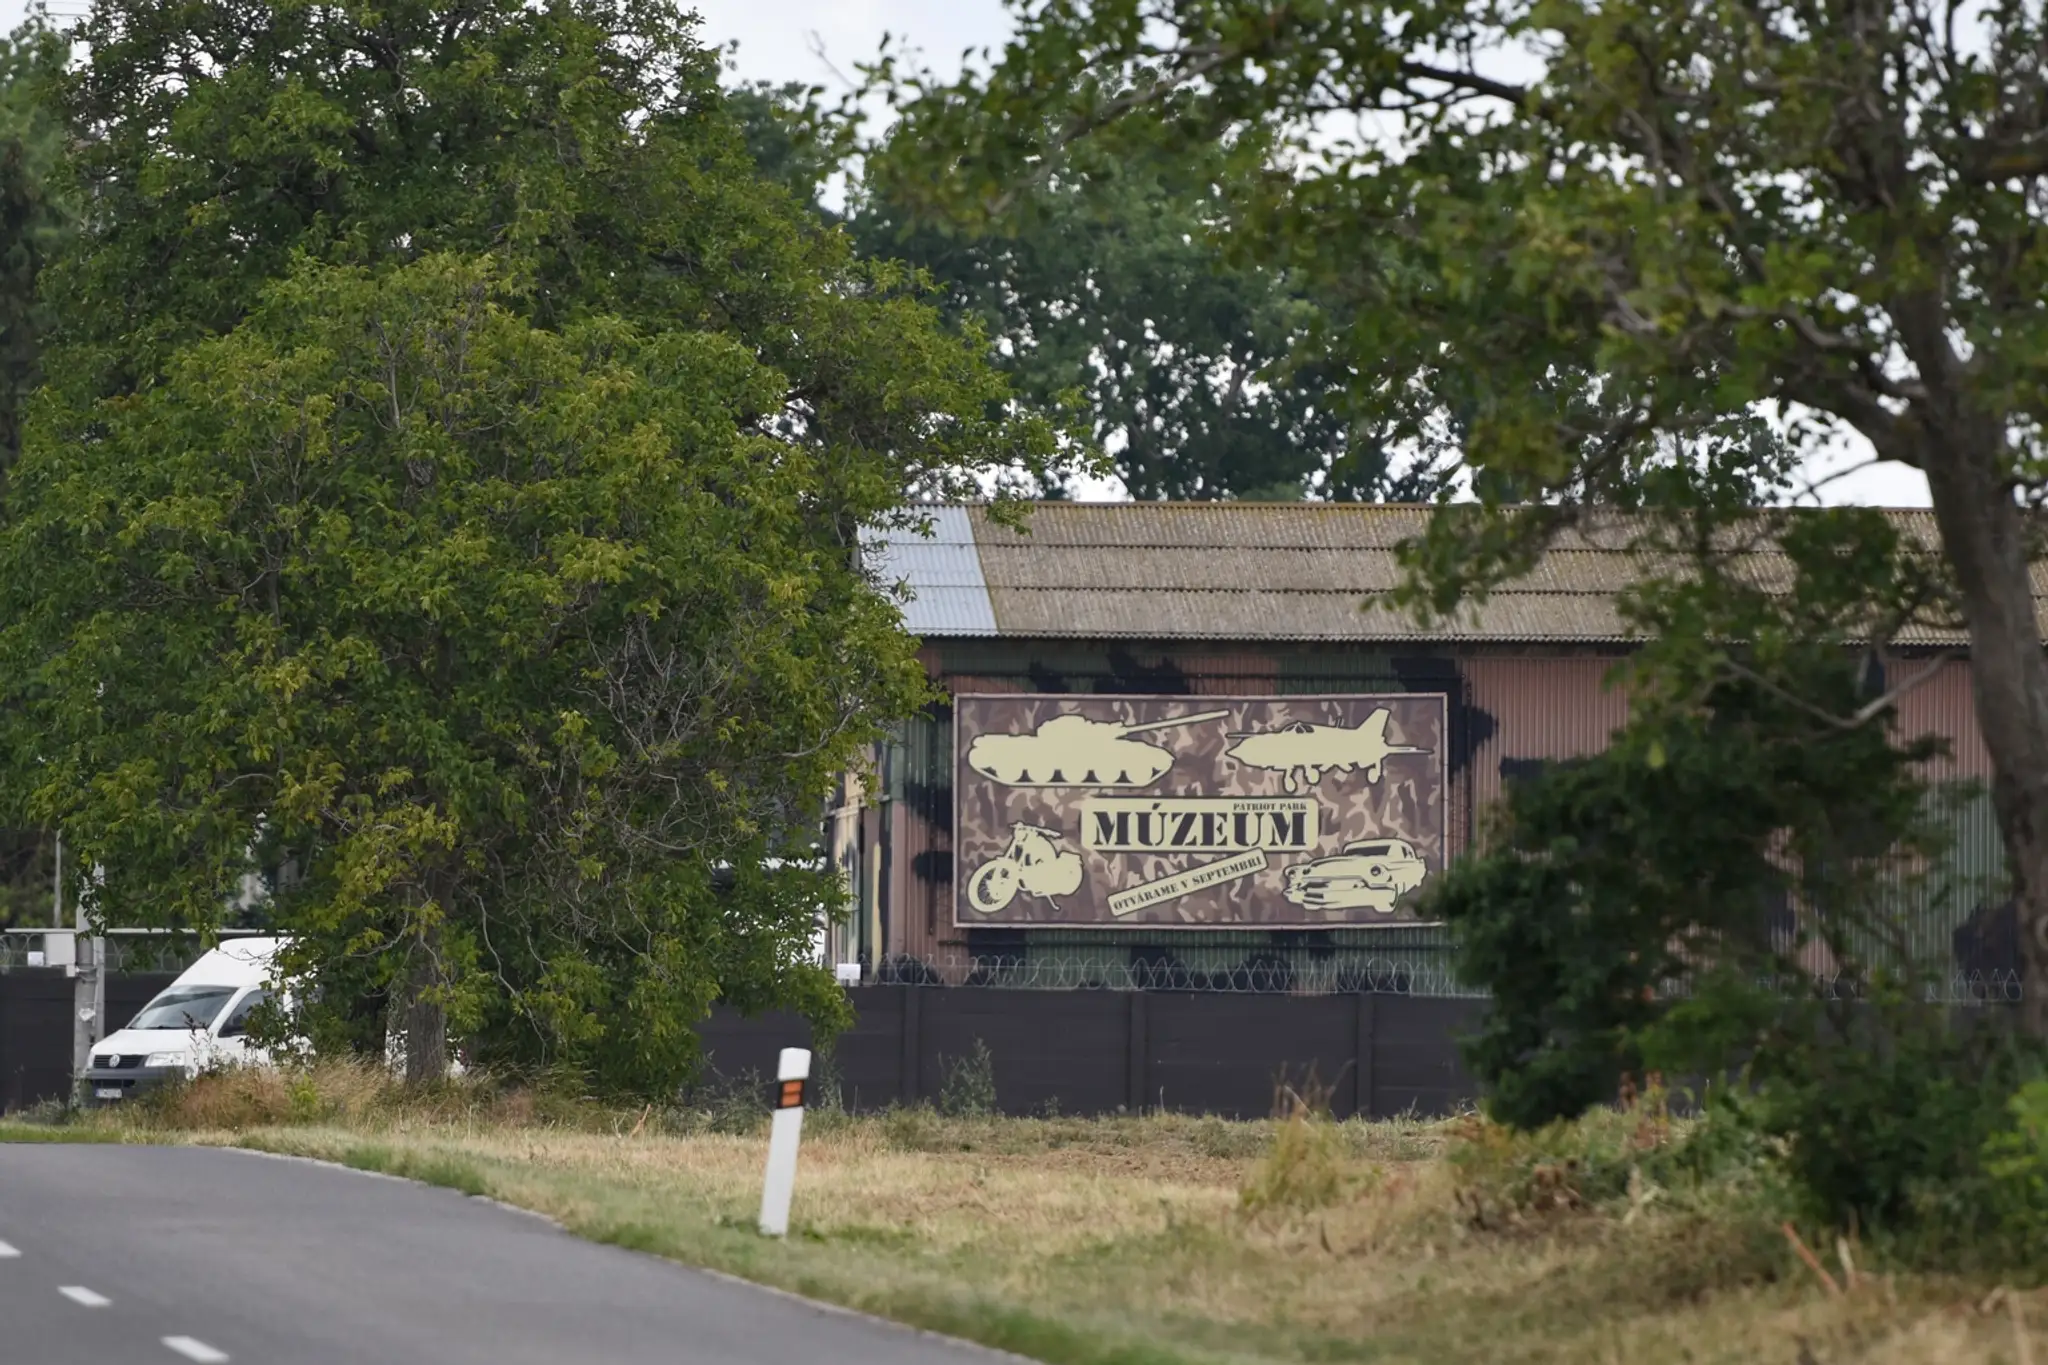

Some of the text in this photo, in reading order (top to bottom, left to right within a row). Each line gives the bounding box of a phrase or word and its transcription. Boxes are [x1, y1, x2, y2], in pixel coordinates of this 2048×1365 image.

[1093, 803, 1306, 846] MÚZEUM
[1233, 803, 1307, 811] PATRIOT PARK
[1113, 856, 1262, 910] OTVÁRAME V SEPTEMBRI
